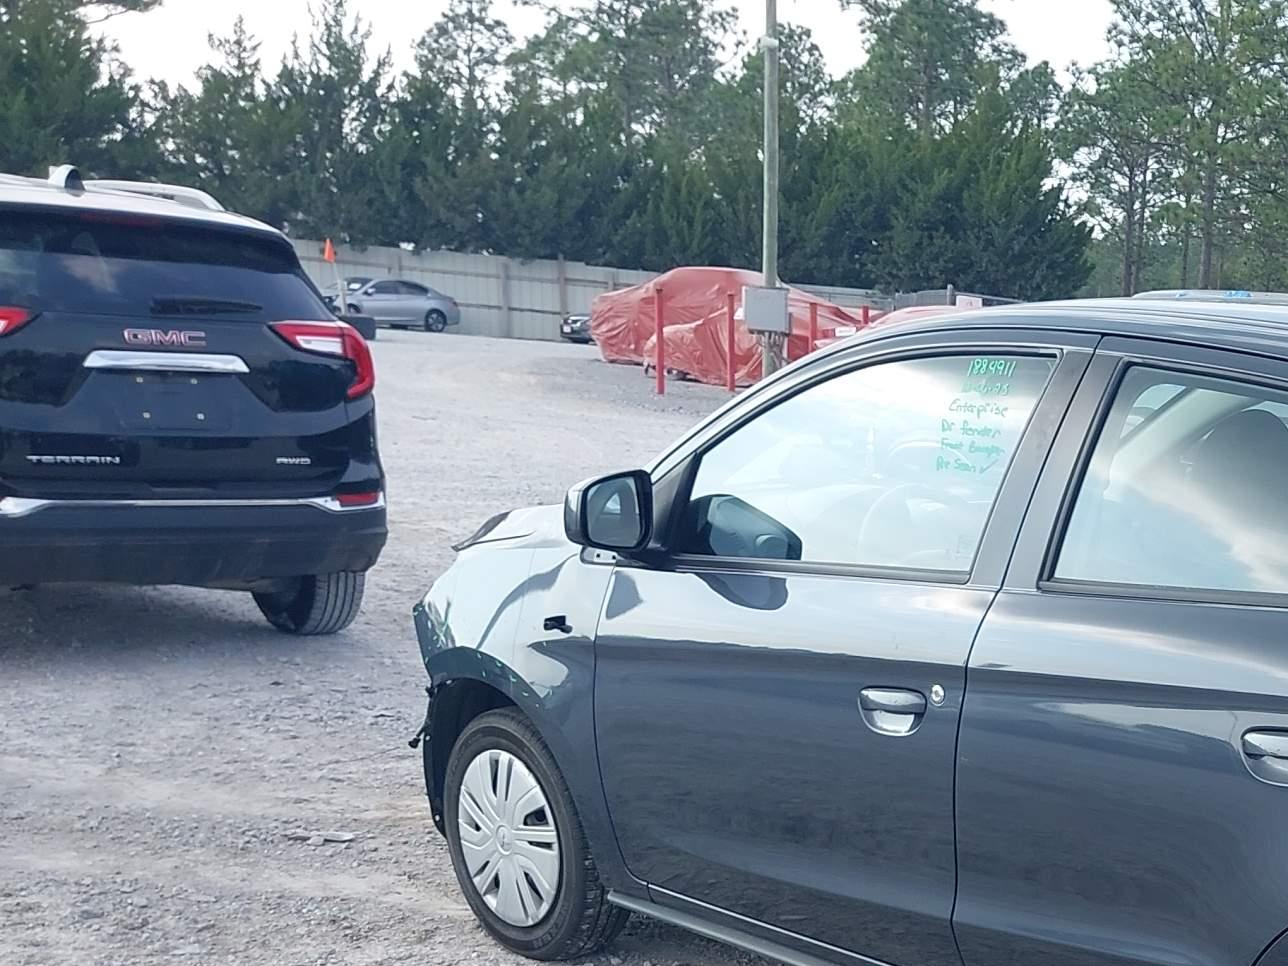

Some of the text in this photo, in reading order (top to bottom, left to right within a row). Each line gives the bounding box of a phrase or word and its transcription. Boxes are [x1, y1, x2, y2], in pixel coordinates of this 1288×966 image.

[123, 328, 207, 346] GMC
[26, 455, 311, 465] TERRAIN AWD
